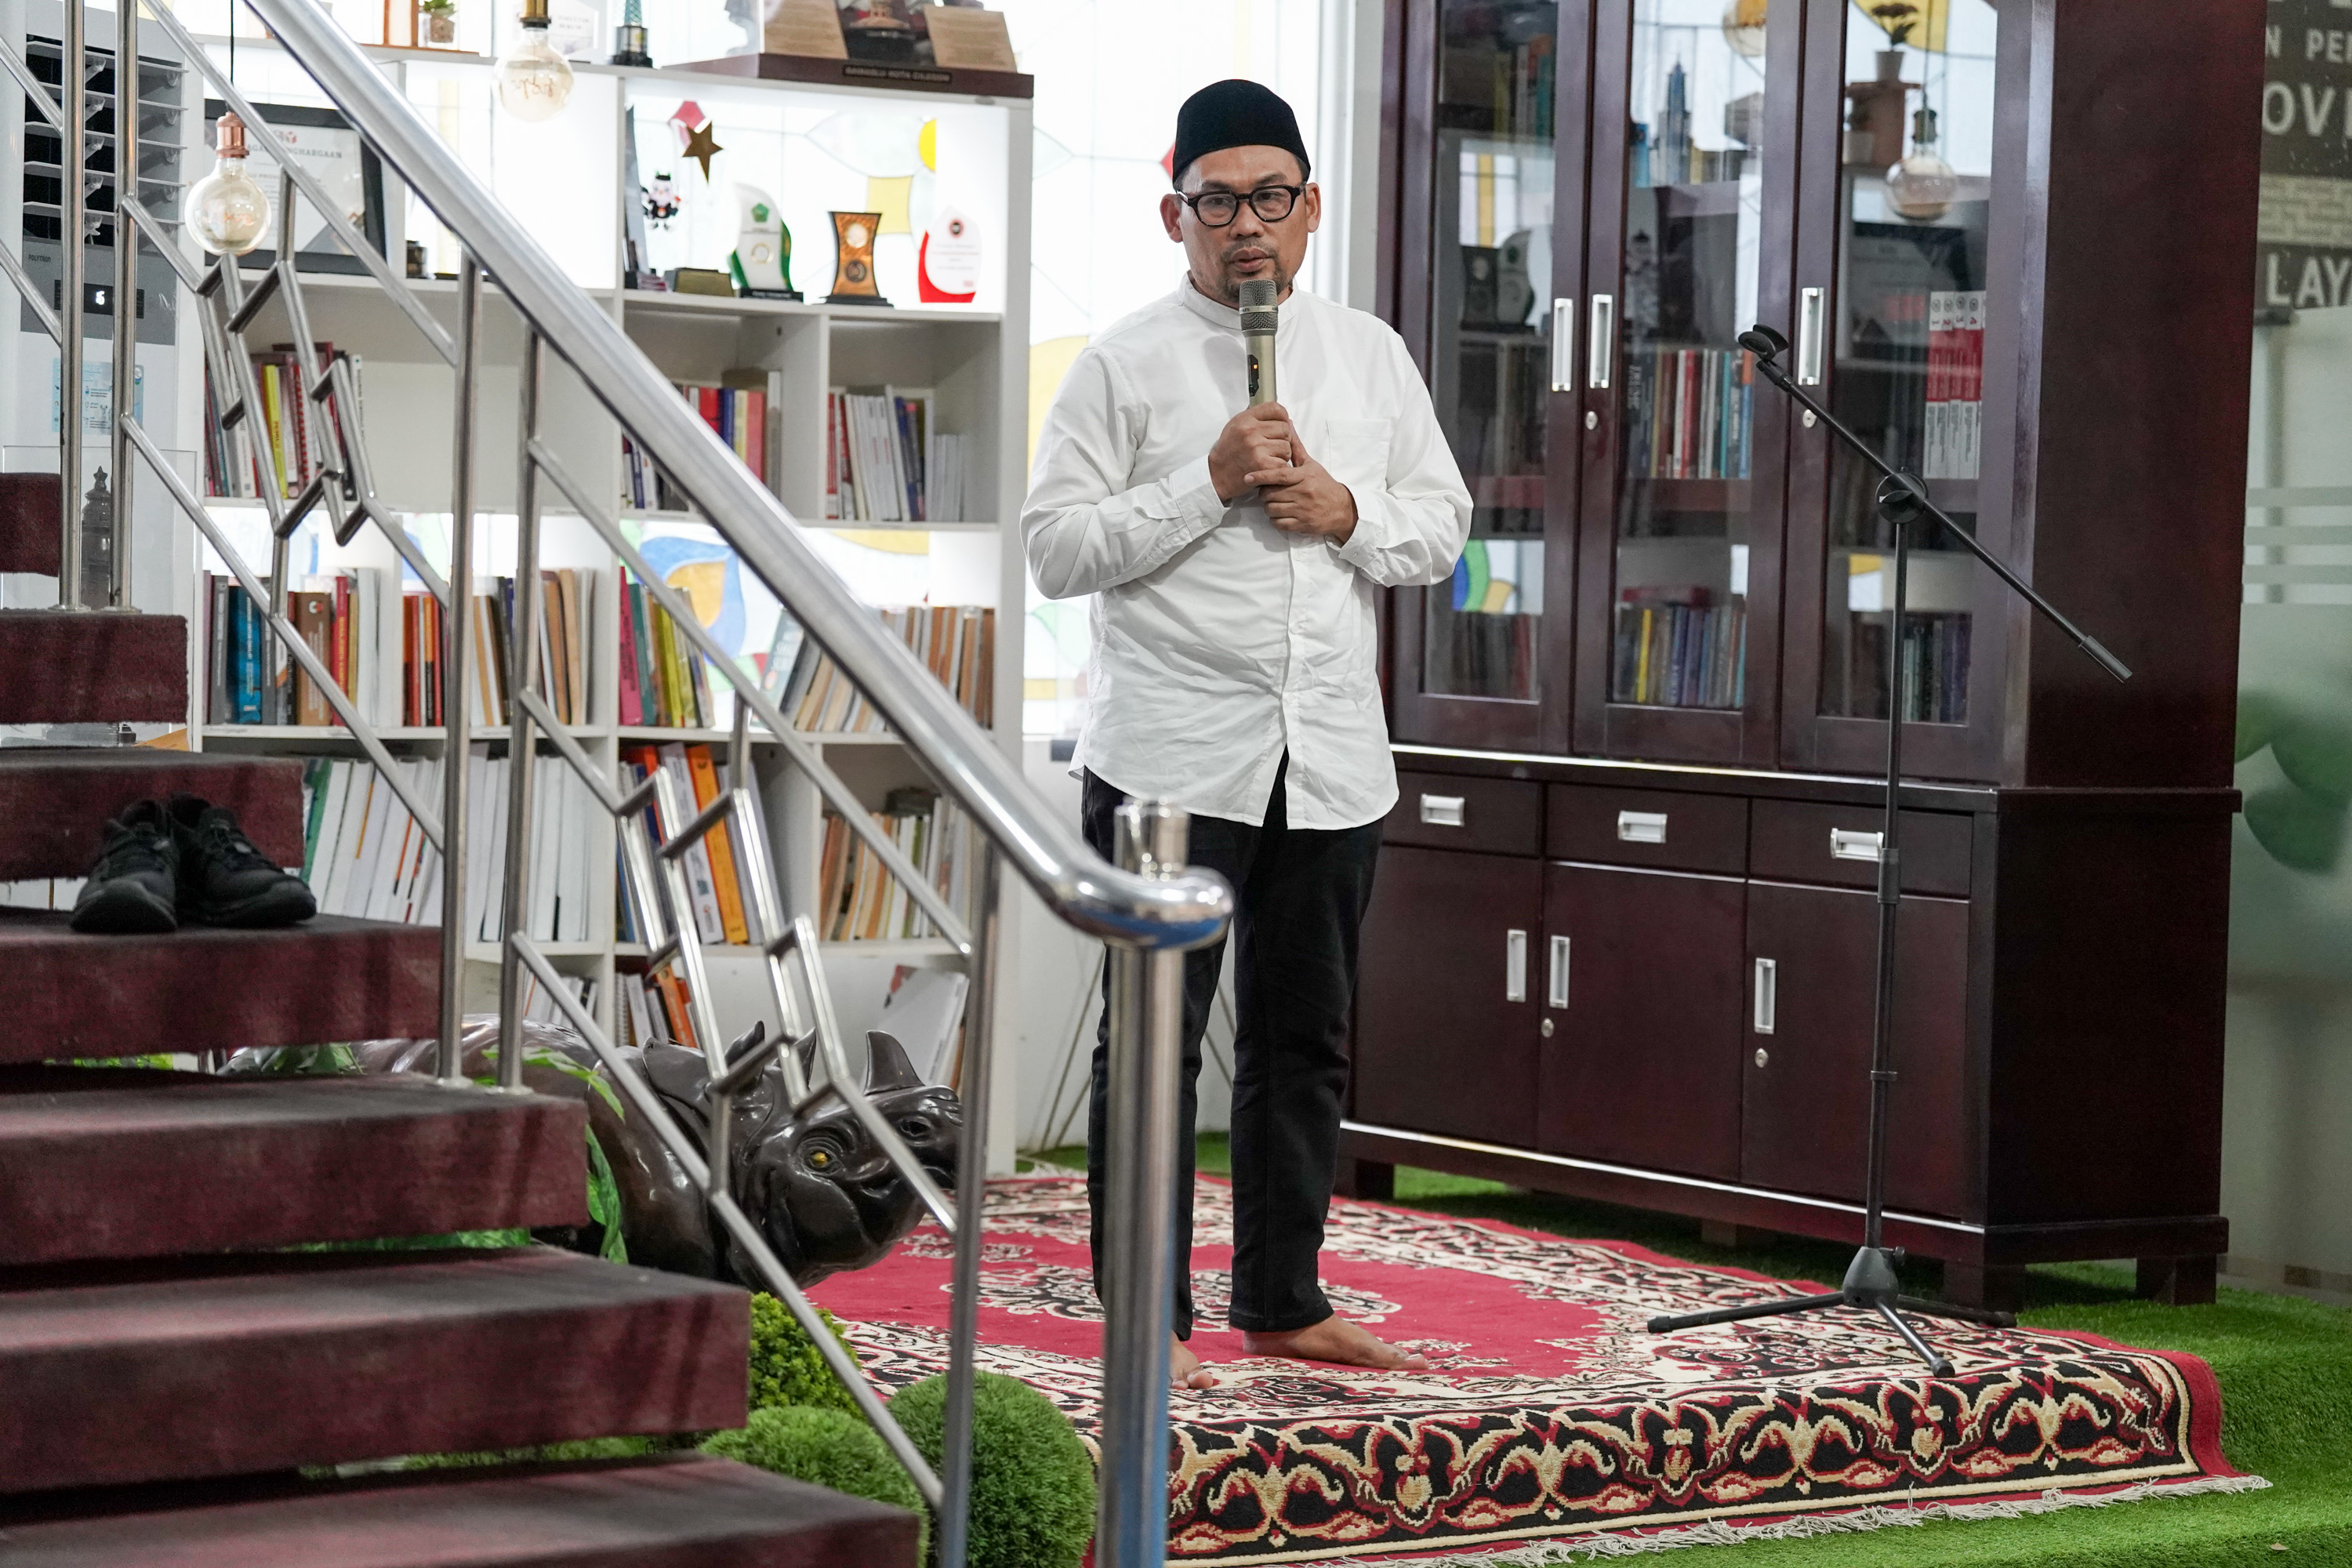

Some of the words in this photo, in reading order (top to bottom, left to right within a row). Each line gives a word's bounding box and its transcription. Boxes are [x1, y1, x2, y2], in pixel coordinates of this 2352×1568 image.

[2262, 82, 2352, 140] OV
[287, 147, 343, 158] NGHARGAAN
[2267, 253, 2352, 307] LAY
